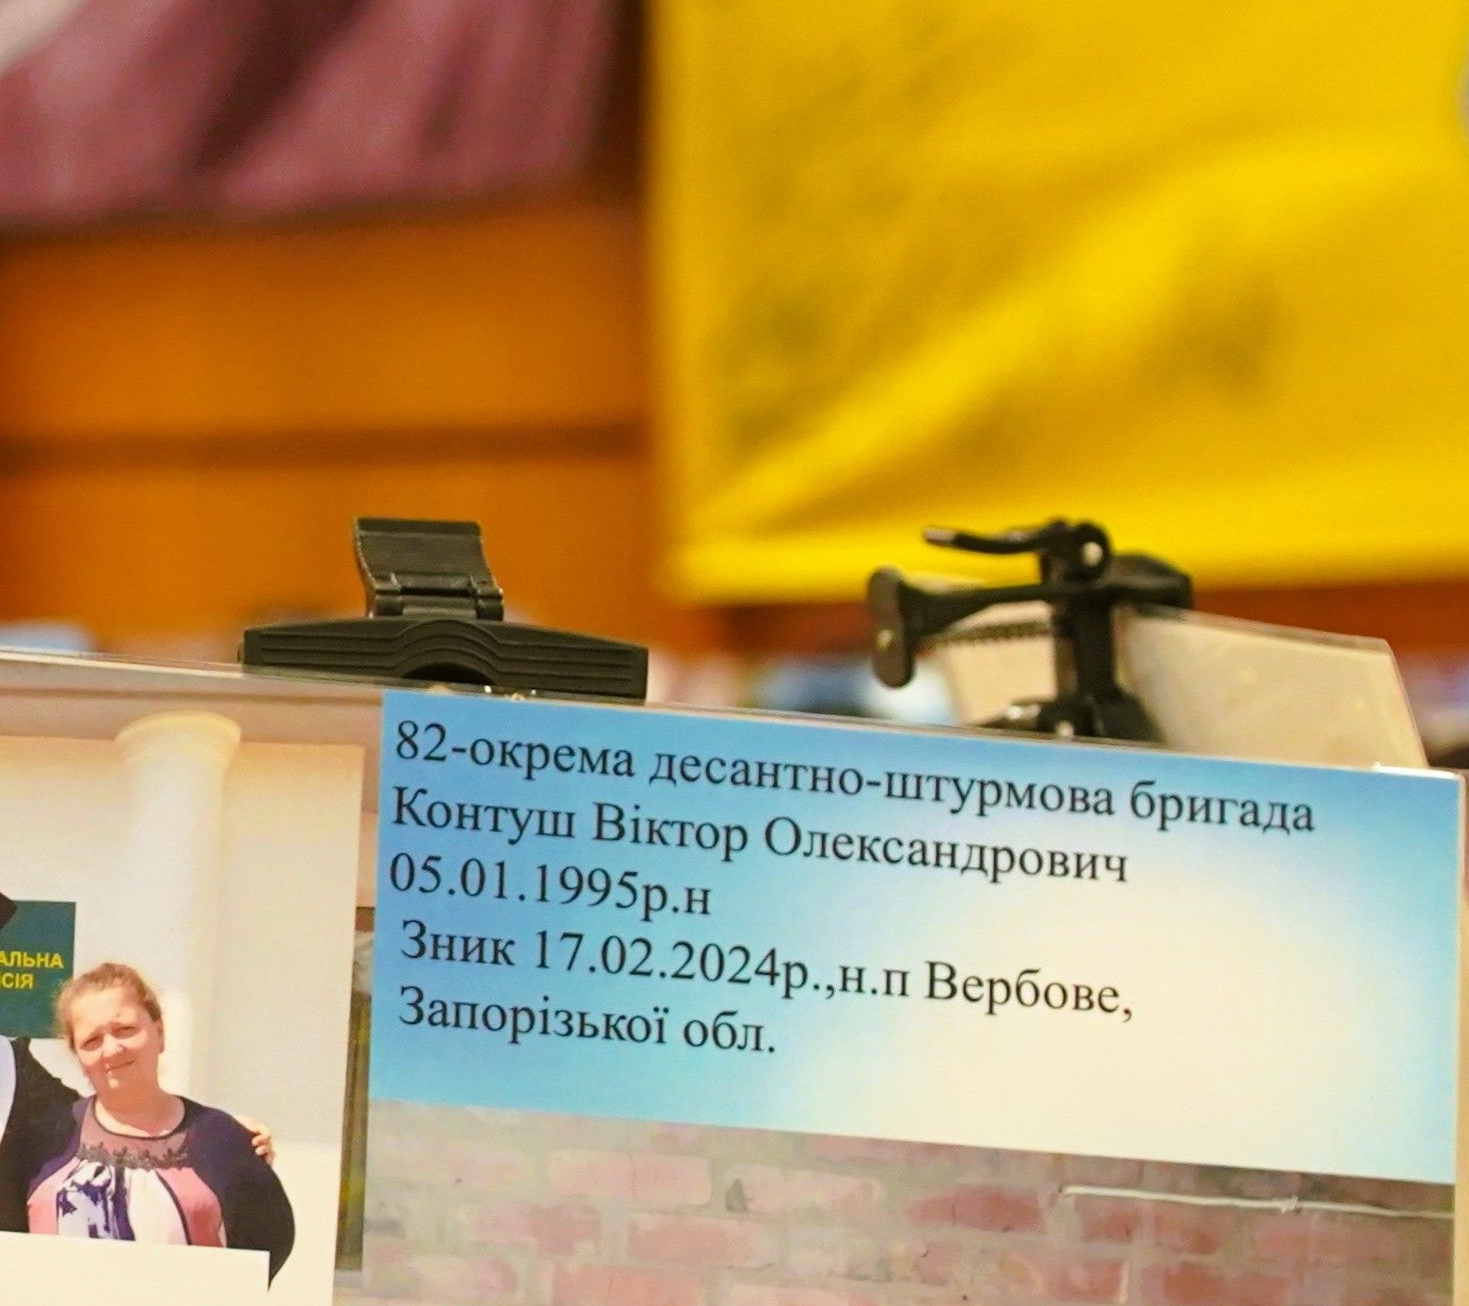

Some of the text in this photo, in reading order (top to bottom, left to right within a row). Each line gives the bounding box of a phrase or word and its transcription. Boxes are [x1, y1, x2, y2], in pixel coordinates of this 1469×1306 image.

[395, 719, 1316, 837] 82-окрема десантно-штурмова бригада
[391, 785, 1129, 885] Контуш Віктор Олександрович
[389, 852, 711, 924] 05.01.1995р.н
[398, 985, 776, 1055] Запорізької обл.
[400, 918, 1133, 1023] Зник 17.02.2024р.,н.п Вербове,
